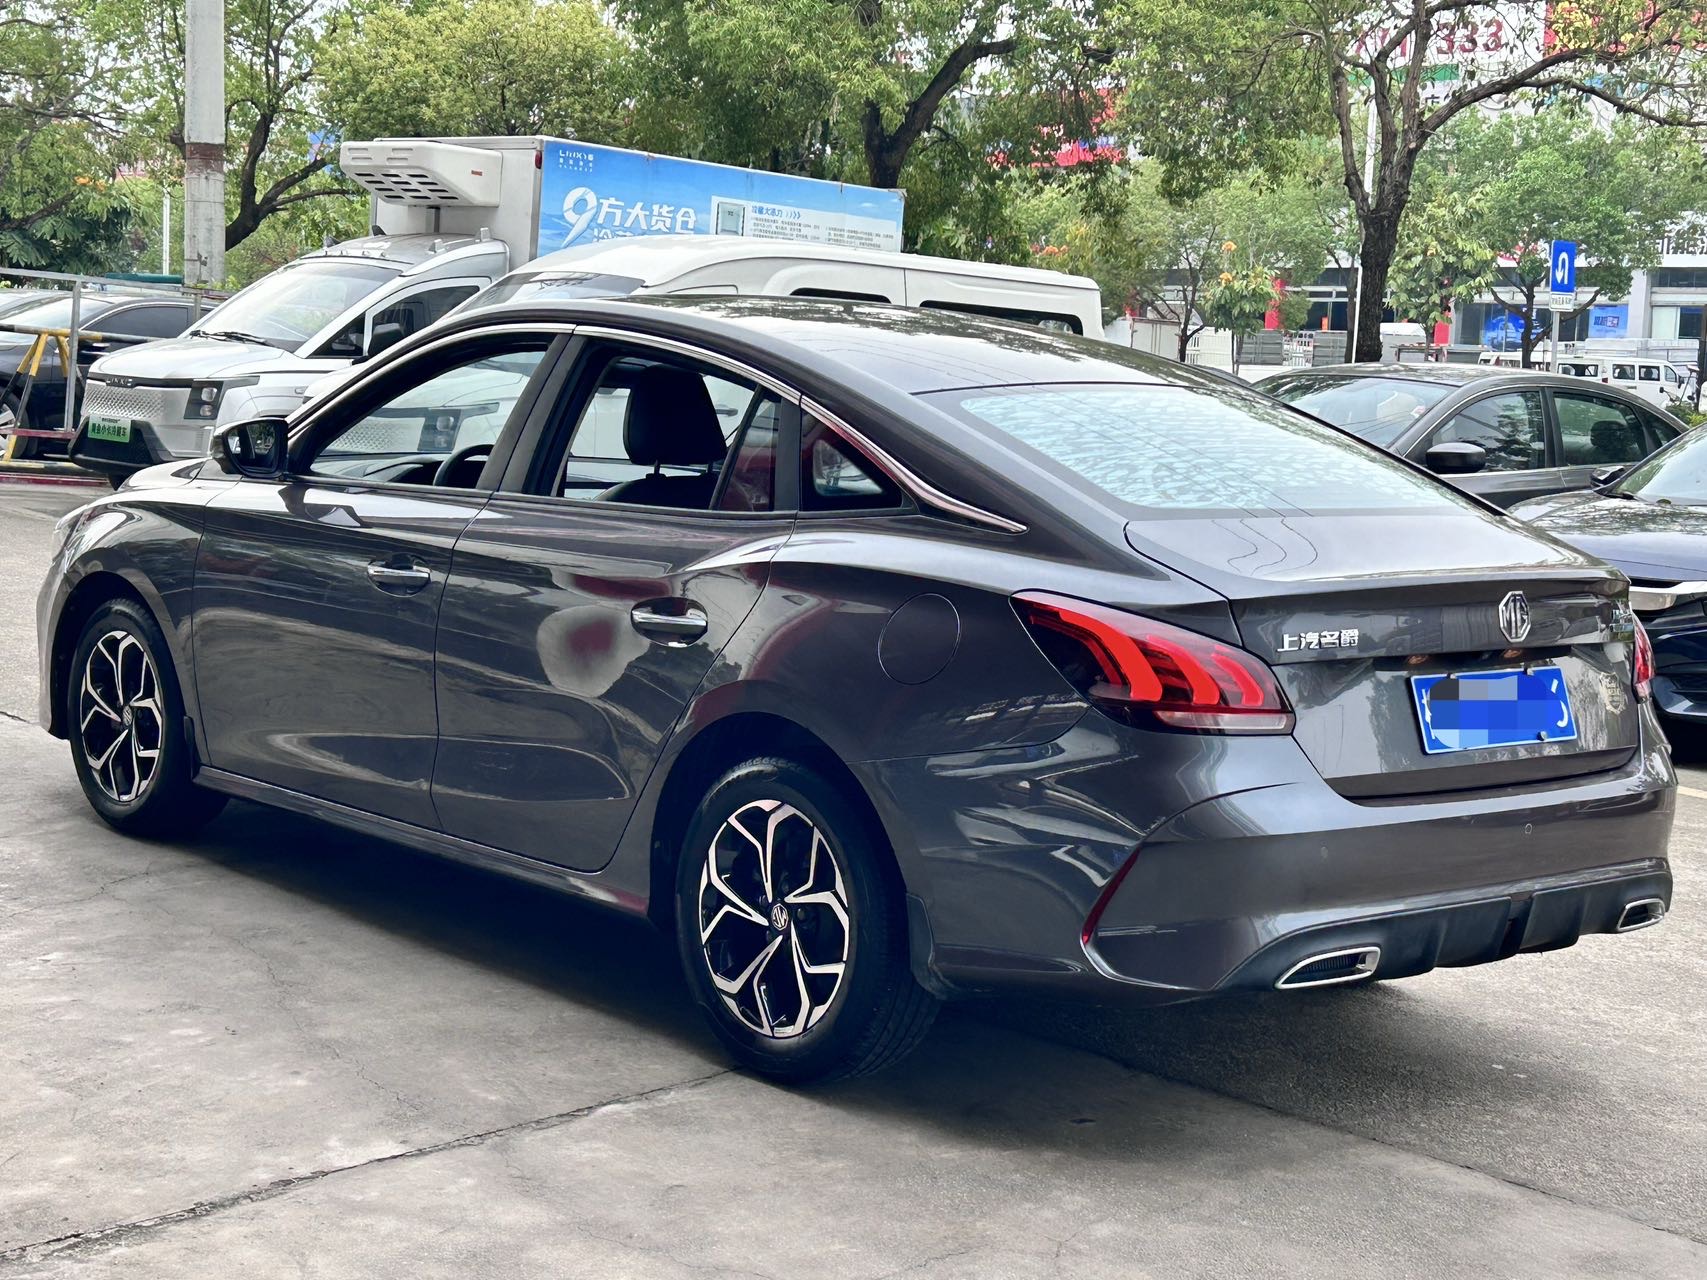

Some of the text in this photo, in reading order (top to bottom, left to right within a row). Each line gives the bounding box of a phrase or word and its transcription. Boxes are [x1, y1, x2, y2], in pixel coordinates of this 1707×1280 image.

[562, 187, 697, 249] 9方大货仓
[1276, 628, 1359, 652] 上汽名爵
[1499, 590, 1531, 642] MG
